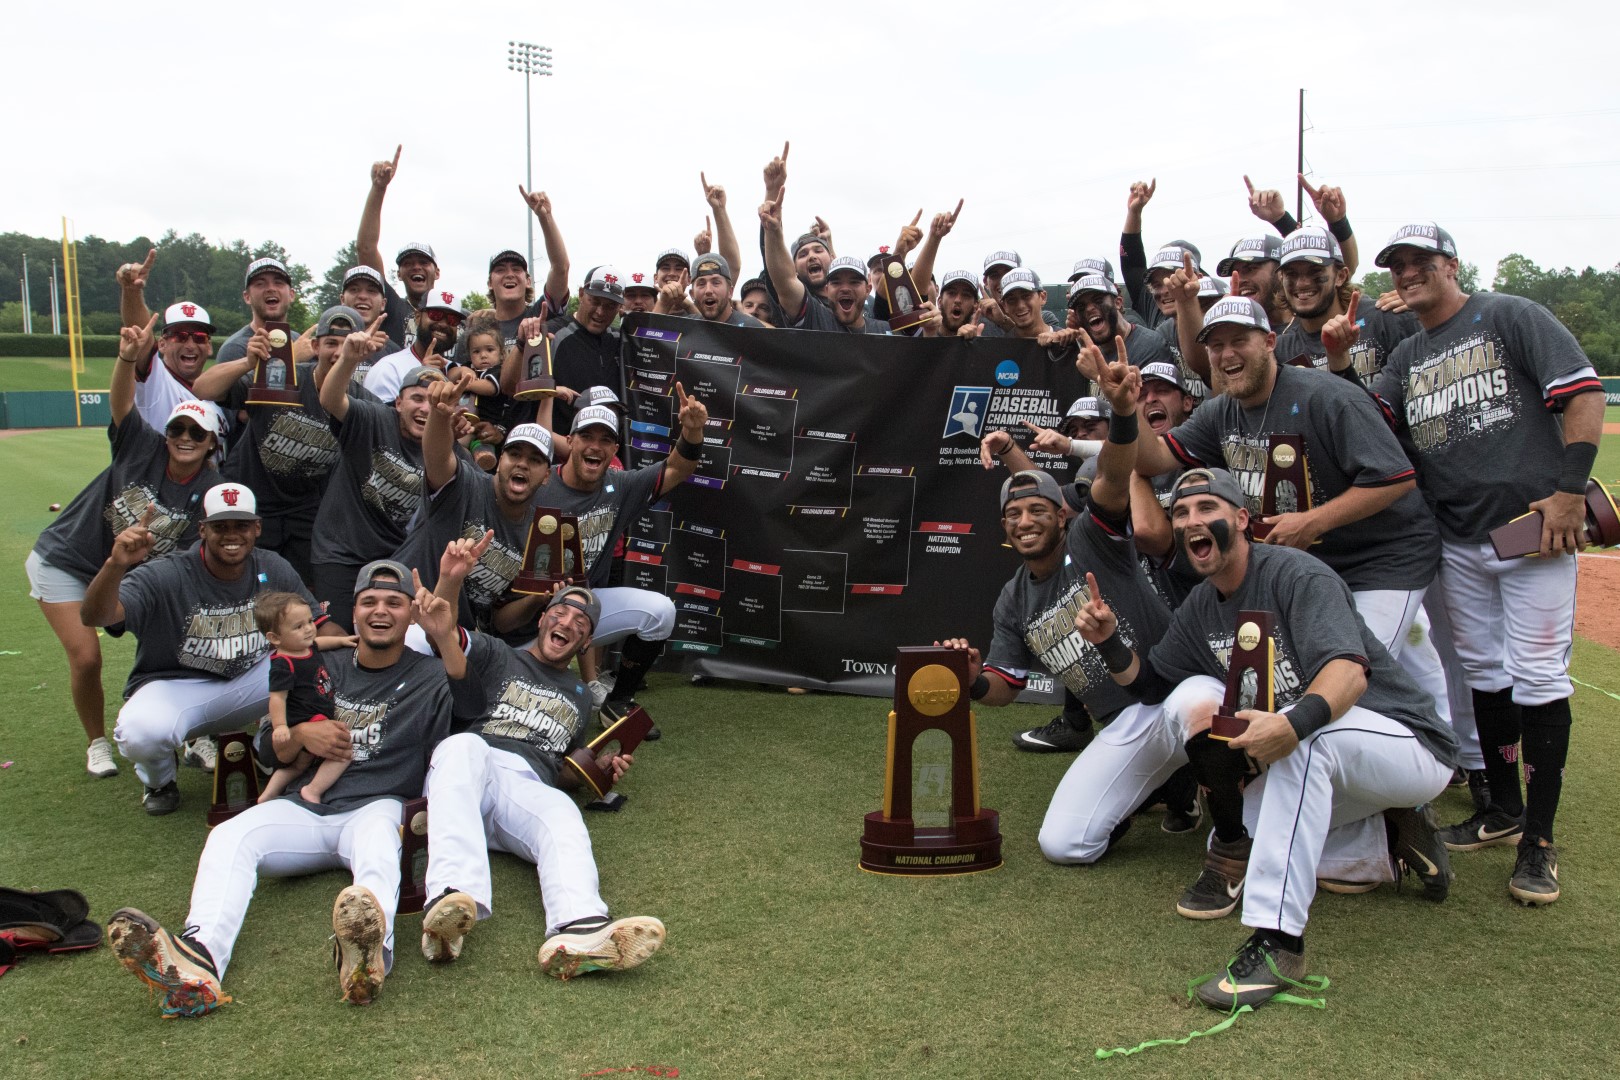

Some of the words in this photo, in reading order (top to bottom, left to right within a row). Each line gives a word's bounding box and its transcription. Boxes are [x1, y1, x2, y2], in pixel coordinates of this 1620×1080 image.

[1281, 237, 1327, 255] CHAMPIONS
[1001, 272, 1033, 286] CHAMPIONS
[1204, 301, 1251, 323] CHAMPIONS
[1453, 335, 1485, 355] BASEBALL
[998, 372, 1019, 381] NCAA
[80, 394, 101, 404] 330
[1407, 368, 1509, 428] CHAMPIONS
[176, 405, 206, 418] TAMPA
[989, 396, 1059, 415] BASEBALL
[580, 411, 617, 426] CHAMPIONS
[986, 413, 1062, 428] CHAMPIONSHIP
[510, 425, 550, 447] CHAMPIONS
[954, 448, 980, 456] Baseball
[1274, 454, 1295, 463] NCAA
[938, 458, 953, 466] Cary,
[928, 536, 960, 544] NATIONAL
[926, 546, 962, 555] CHAMPION
[209, 606, 235, 616] DIVISION
[1238, 634, 1259, 645] NCAA
[530, 687, 557, 698] DIVISION
[1027, 679, 1052, 693] LIVE
[912, 688, 959, 705] NCAA
[895, 854, 932, 866] NATIONAL
[934, 853, 976, 865] CHAMPION
